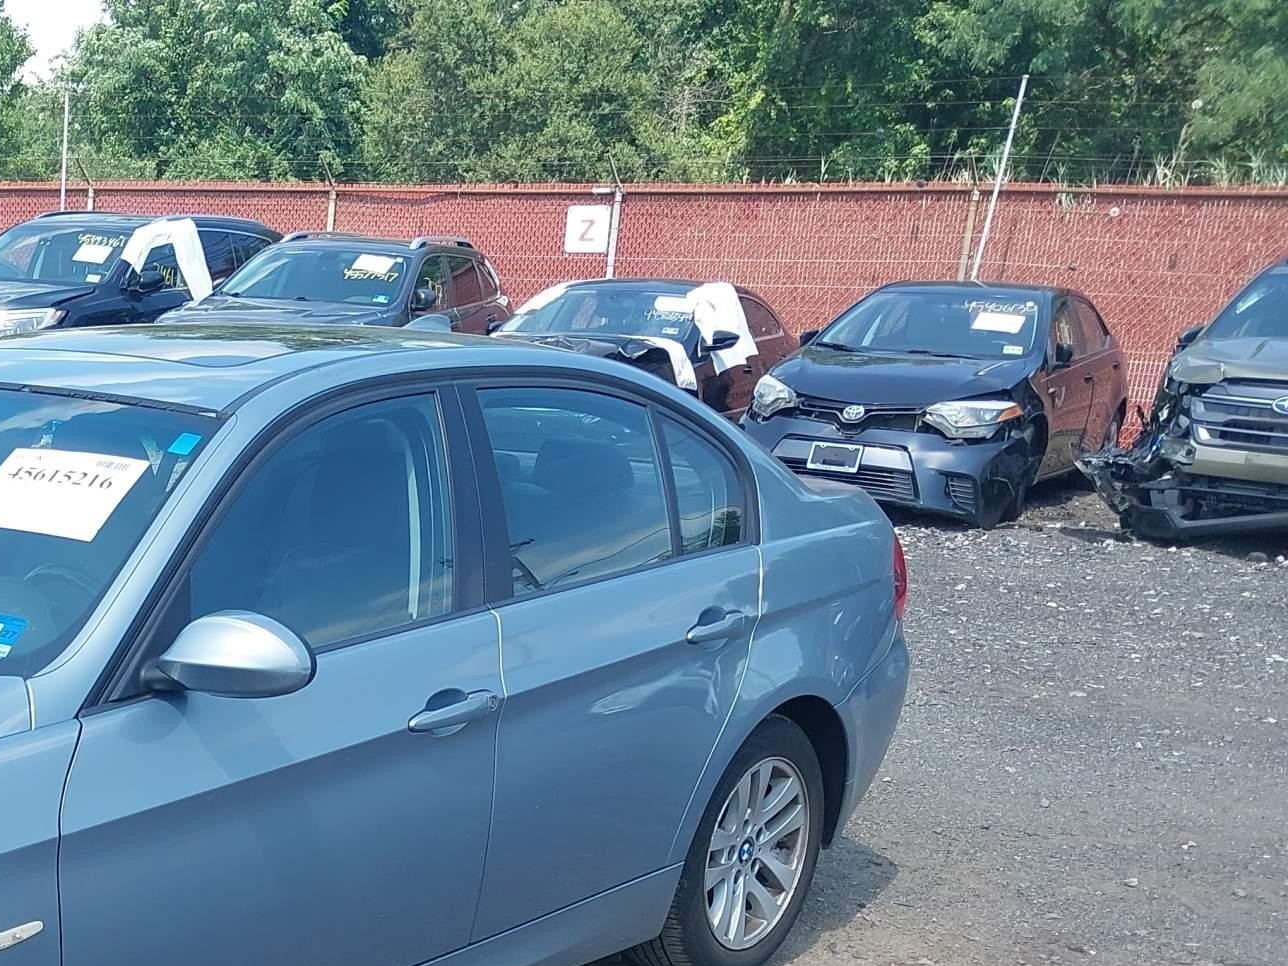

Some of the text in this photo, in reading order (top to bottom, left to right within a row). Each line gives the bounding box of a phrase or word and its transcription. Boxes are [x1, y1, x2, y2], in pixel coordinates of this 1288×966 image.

[579, 219, 595, 241] Z
[8, 466, 113, 490] 45615216
[0, 629, 18, 639] 27
